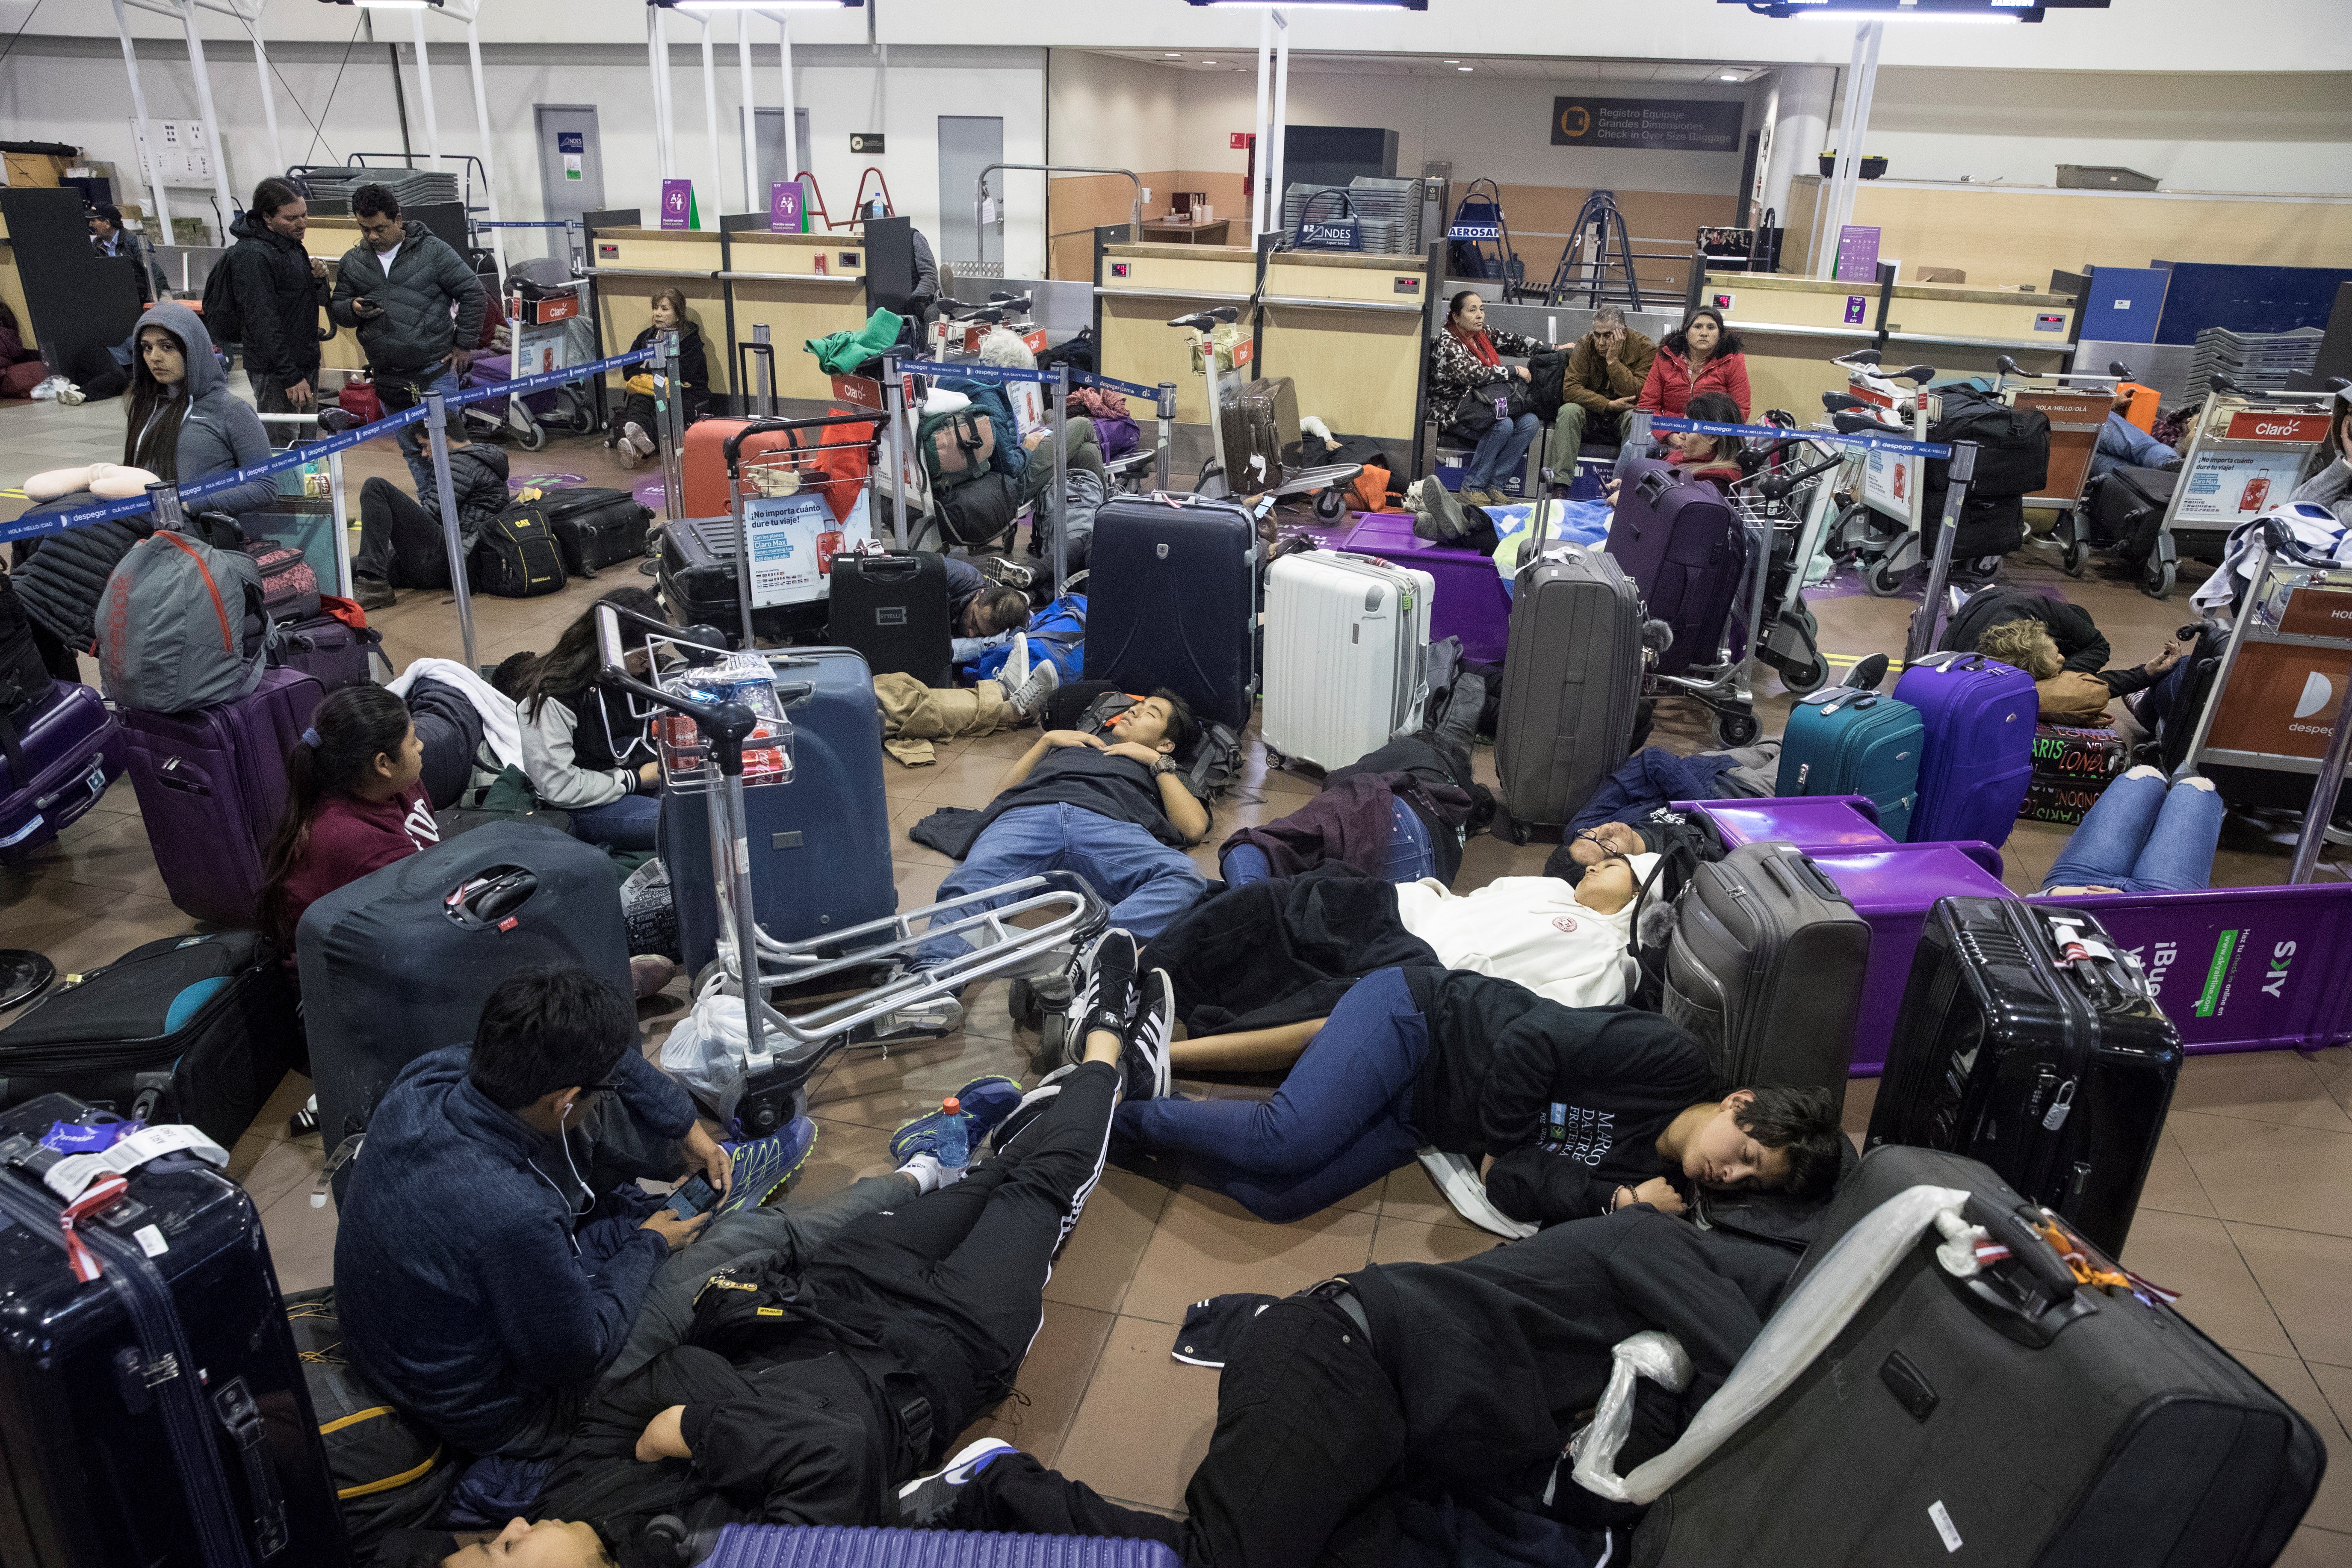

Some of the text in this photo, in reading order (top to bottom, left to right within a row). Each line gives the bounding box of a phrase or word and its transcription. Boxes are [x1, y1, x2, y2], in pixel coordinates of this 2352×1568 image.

[1600, 108, 1684, 120] Registro Equipaje
[1599, 118, 1704, 130] Grandes Dimensiones
[1597, 129, 1626, 139] Check
[1641, 130, 1663, 140] Over
[1667, 132, 1686, 142] Size
[1689, 133, 1731, 144] Baggage
[845, 384, 866, 400] Claro
[2255, 422, 2293, 436] Claro
[247, 465, 269, 476] despegar
[307, 445, 327, 456] despegar
[362, 426, 380, 436] despegar
[411, 407, 427, 417] despegar
[1882, 442, 1914, 451] despegar
[73, 509, 106, 522] despegar
[751, 504, 821, 520] ¡No importa cuánto
[514, 519, 531, 528] CAT
[752, 516, 800, 529] dure tu viaje!
[754, 541, 772, 549] Claro
[2032, 738, 2065, 760] ARIS
[28, 818, 42, 831] 067420
[2202, 935, 2231, 1012] www.skyairline.com
[2217, 929, 2251, 1016] Haz tu check in online en
[2261, 941, 2297, 998] SKY
[1585, 1111, 1615, 1166] MARCO
